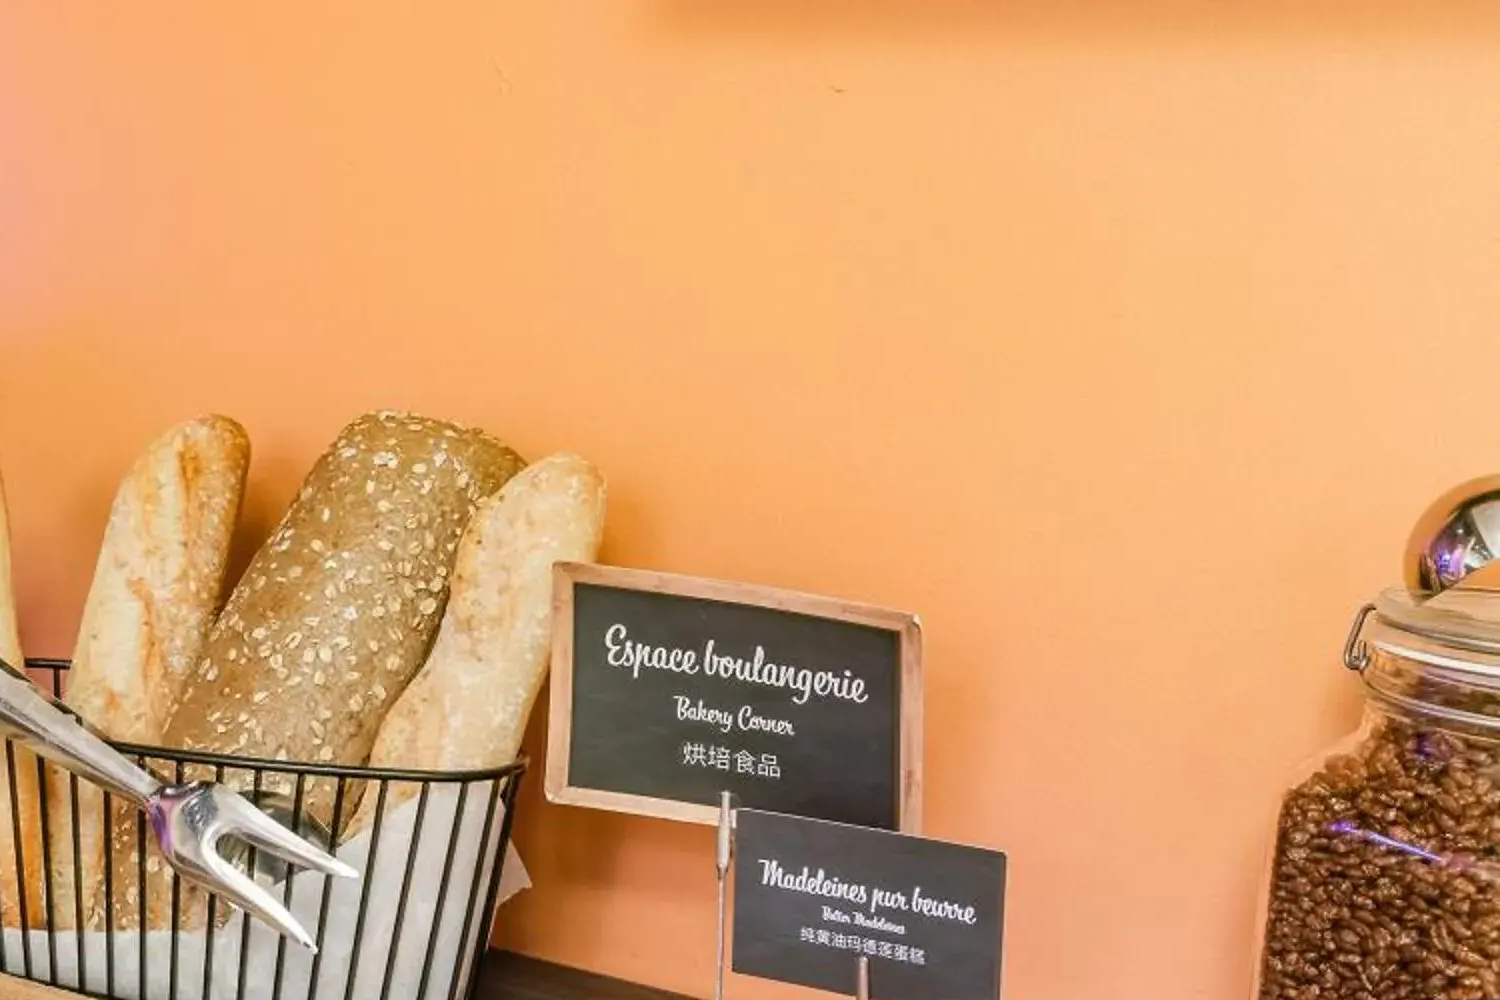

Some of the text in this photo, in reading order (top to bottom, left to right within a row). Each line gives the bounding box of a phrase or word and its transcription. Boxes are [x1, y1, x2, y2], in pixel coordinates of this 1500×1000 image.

[605, 624, 869, 704] Espace boulangerie
[673, 695, 796, 736] Bakery Corner
[758, 859, 978, 925] Madeleines pur beurre
